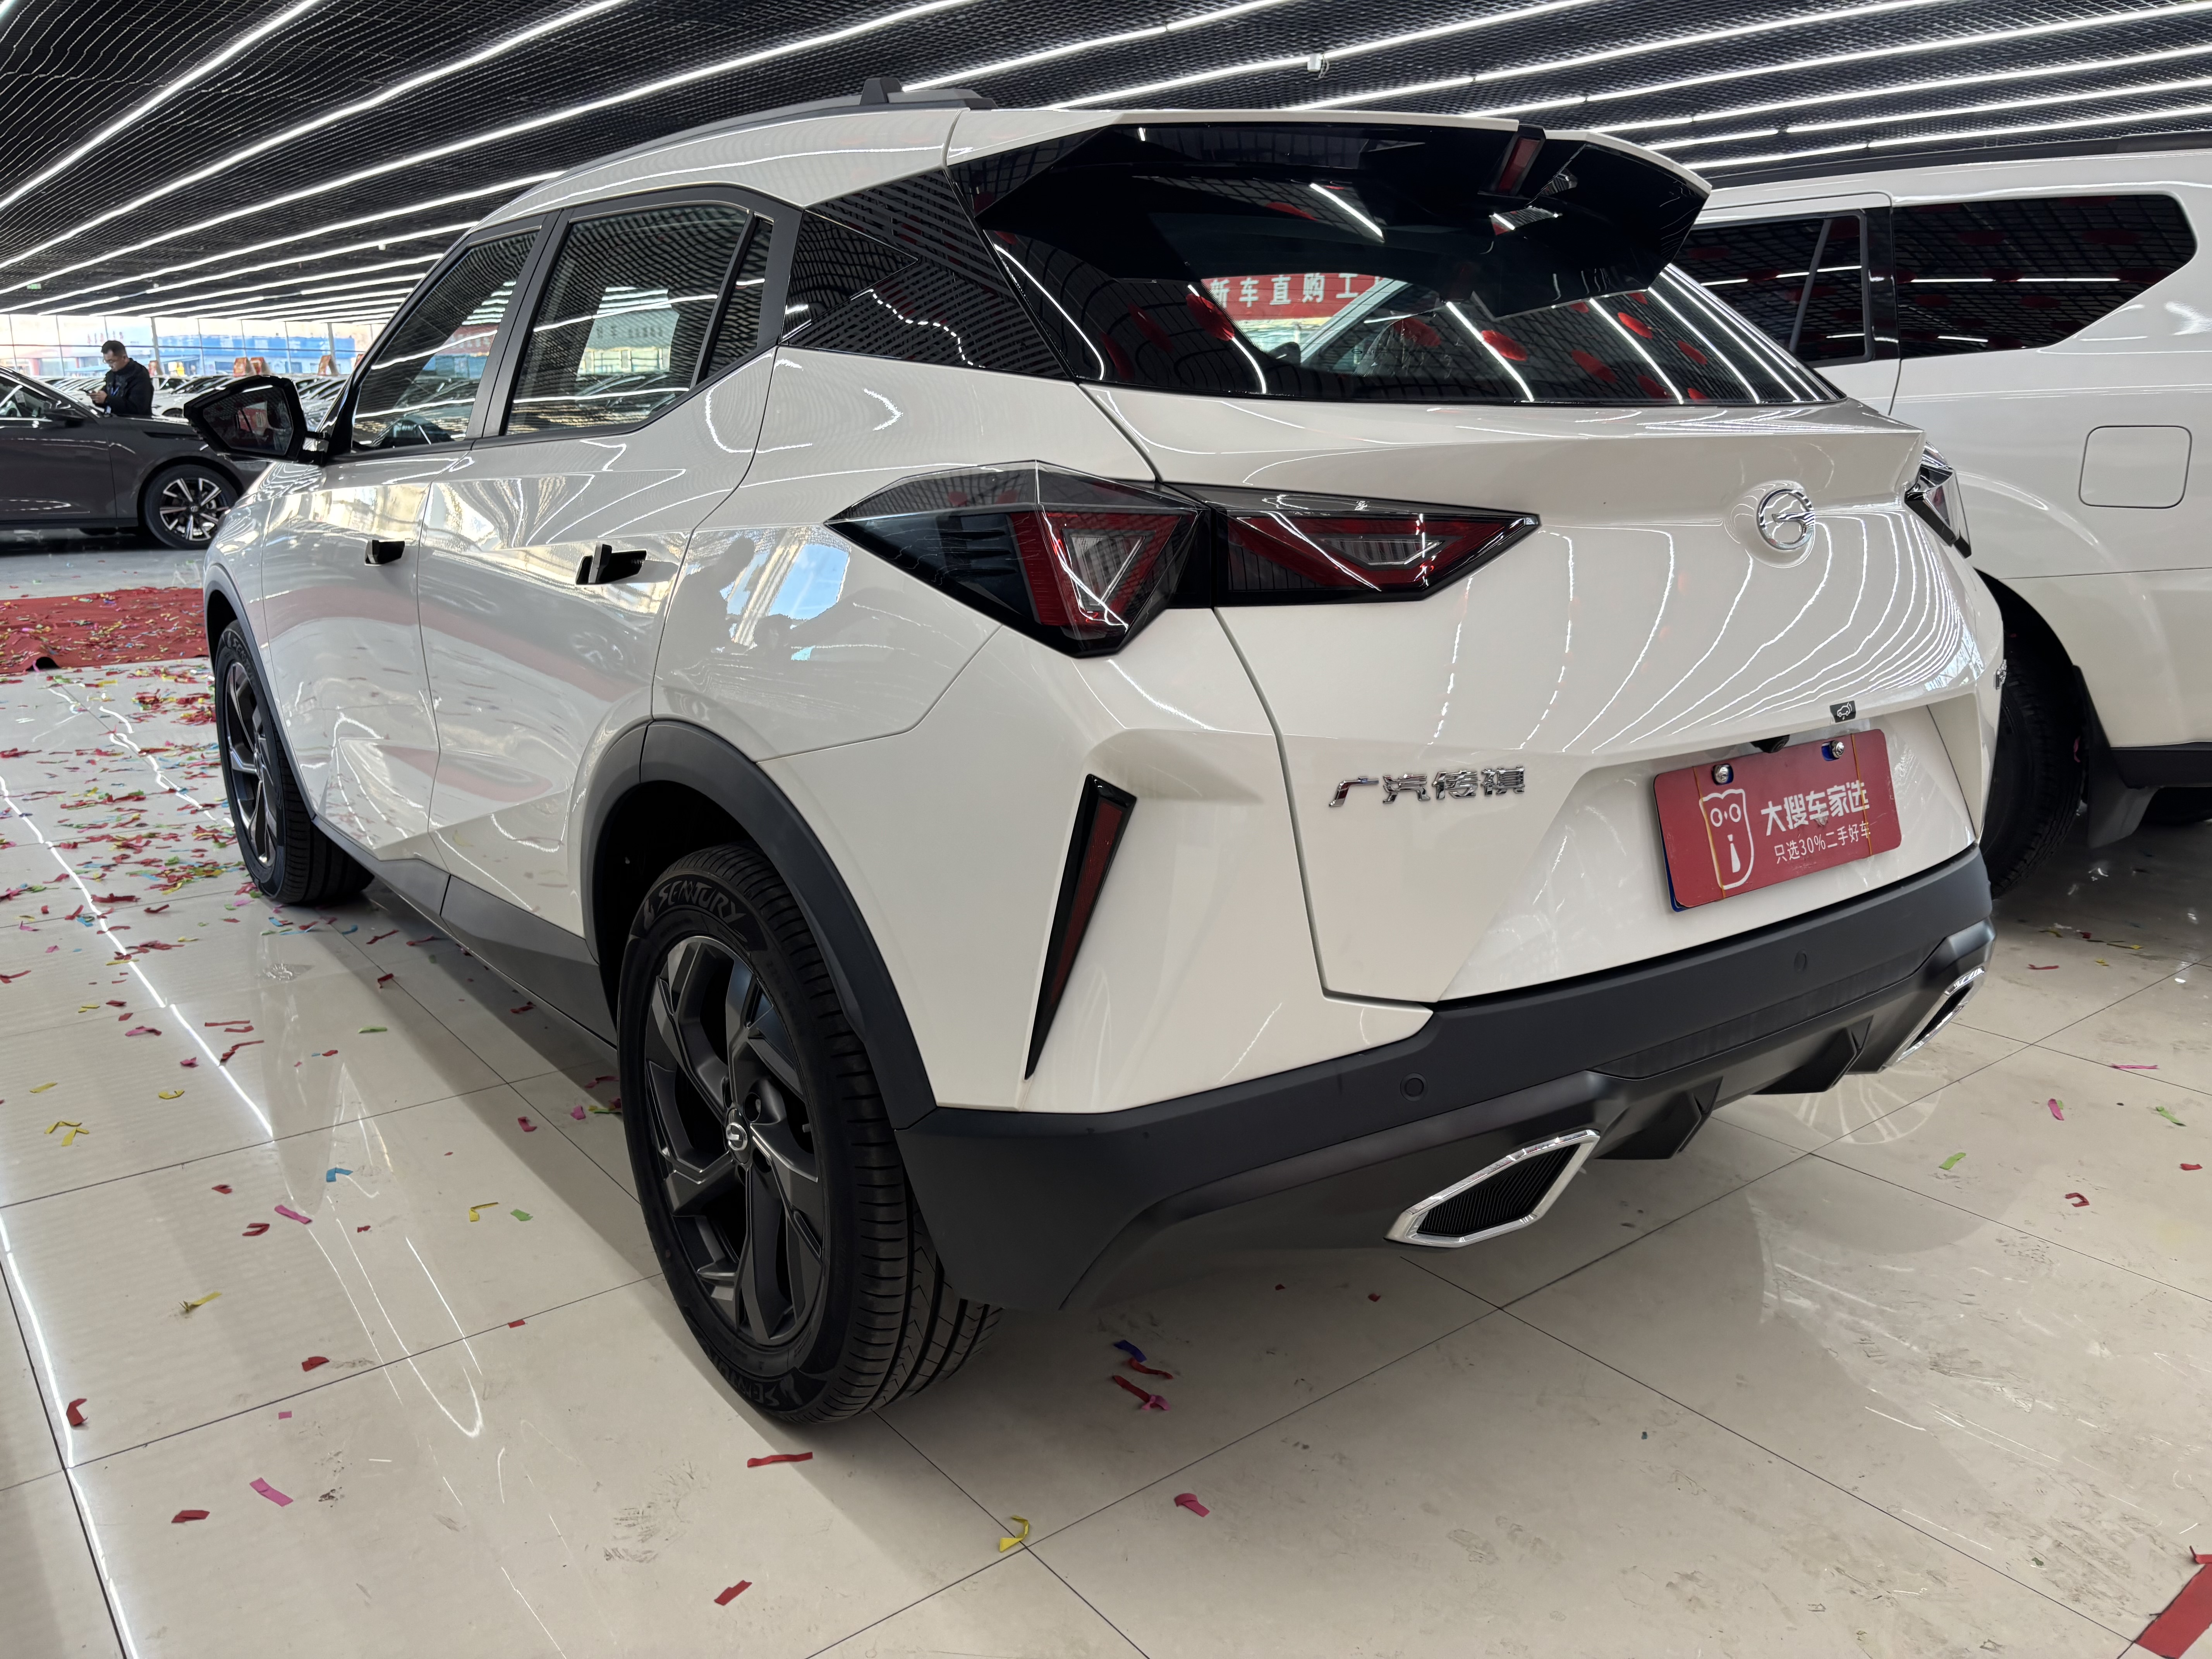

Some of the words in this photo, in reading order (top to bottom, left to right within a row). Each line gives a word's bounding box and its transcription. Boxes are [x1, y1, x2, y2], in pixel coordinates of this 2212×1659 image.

[1210, 273, 1382, 309] 新车直购工
[1761, 780, 1870, 836] 大搜车家选
[1774, 821, 1870, 864] 只选30%二手好车
[657, 880, 747, 923] SENTURY
